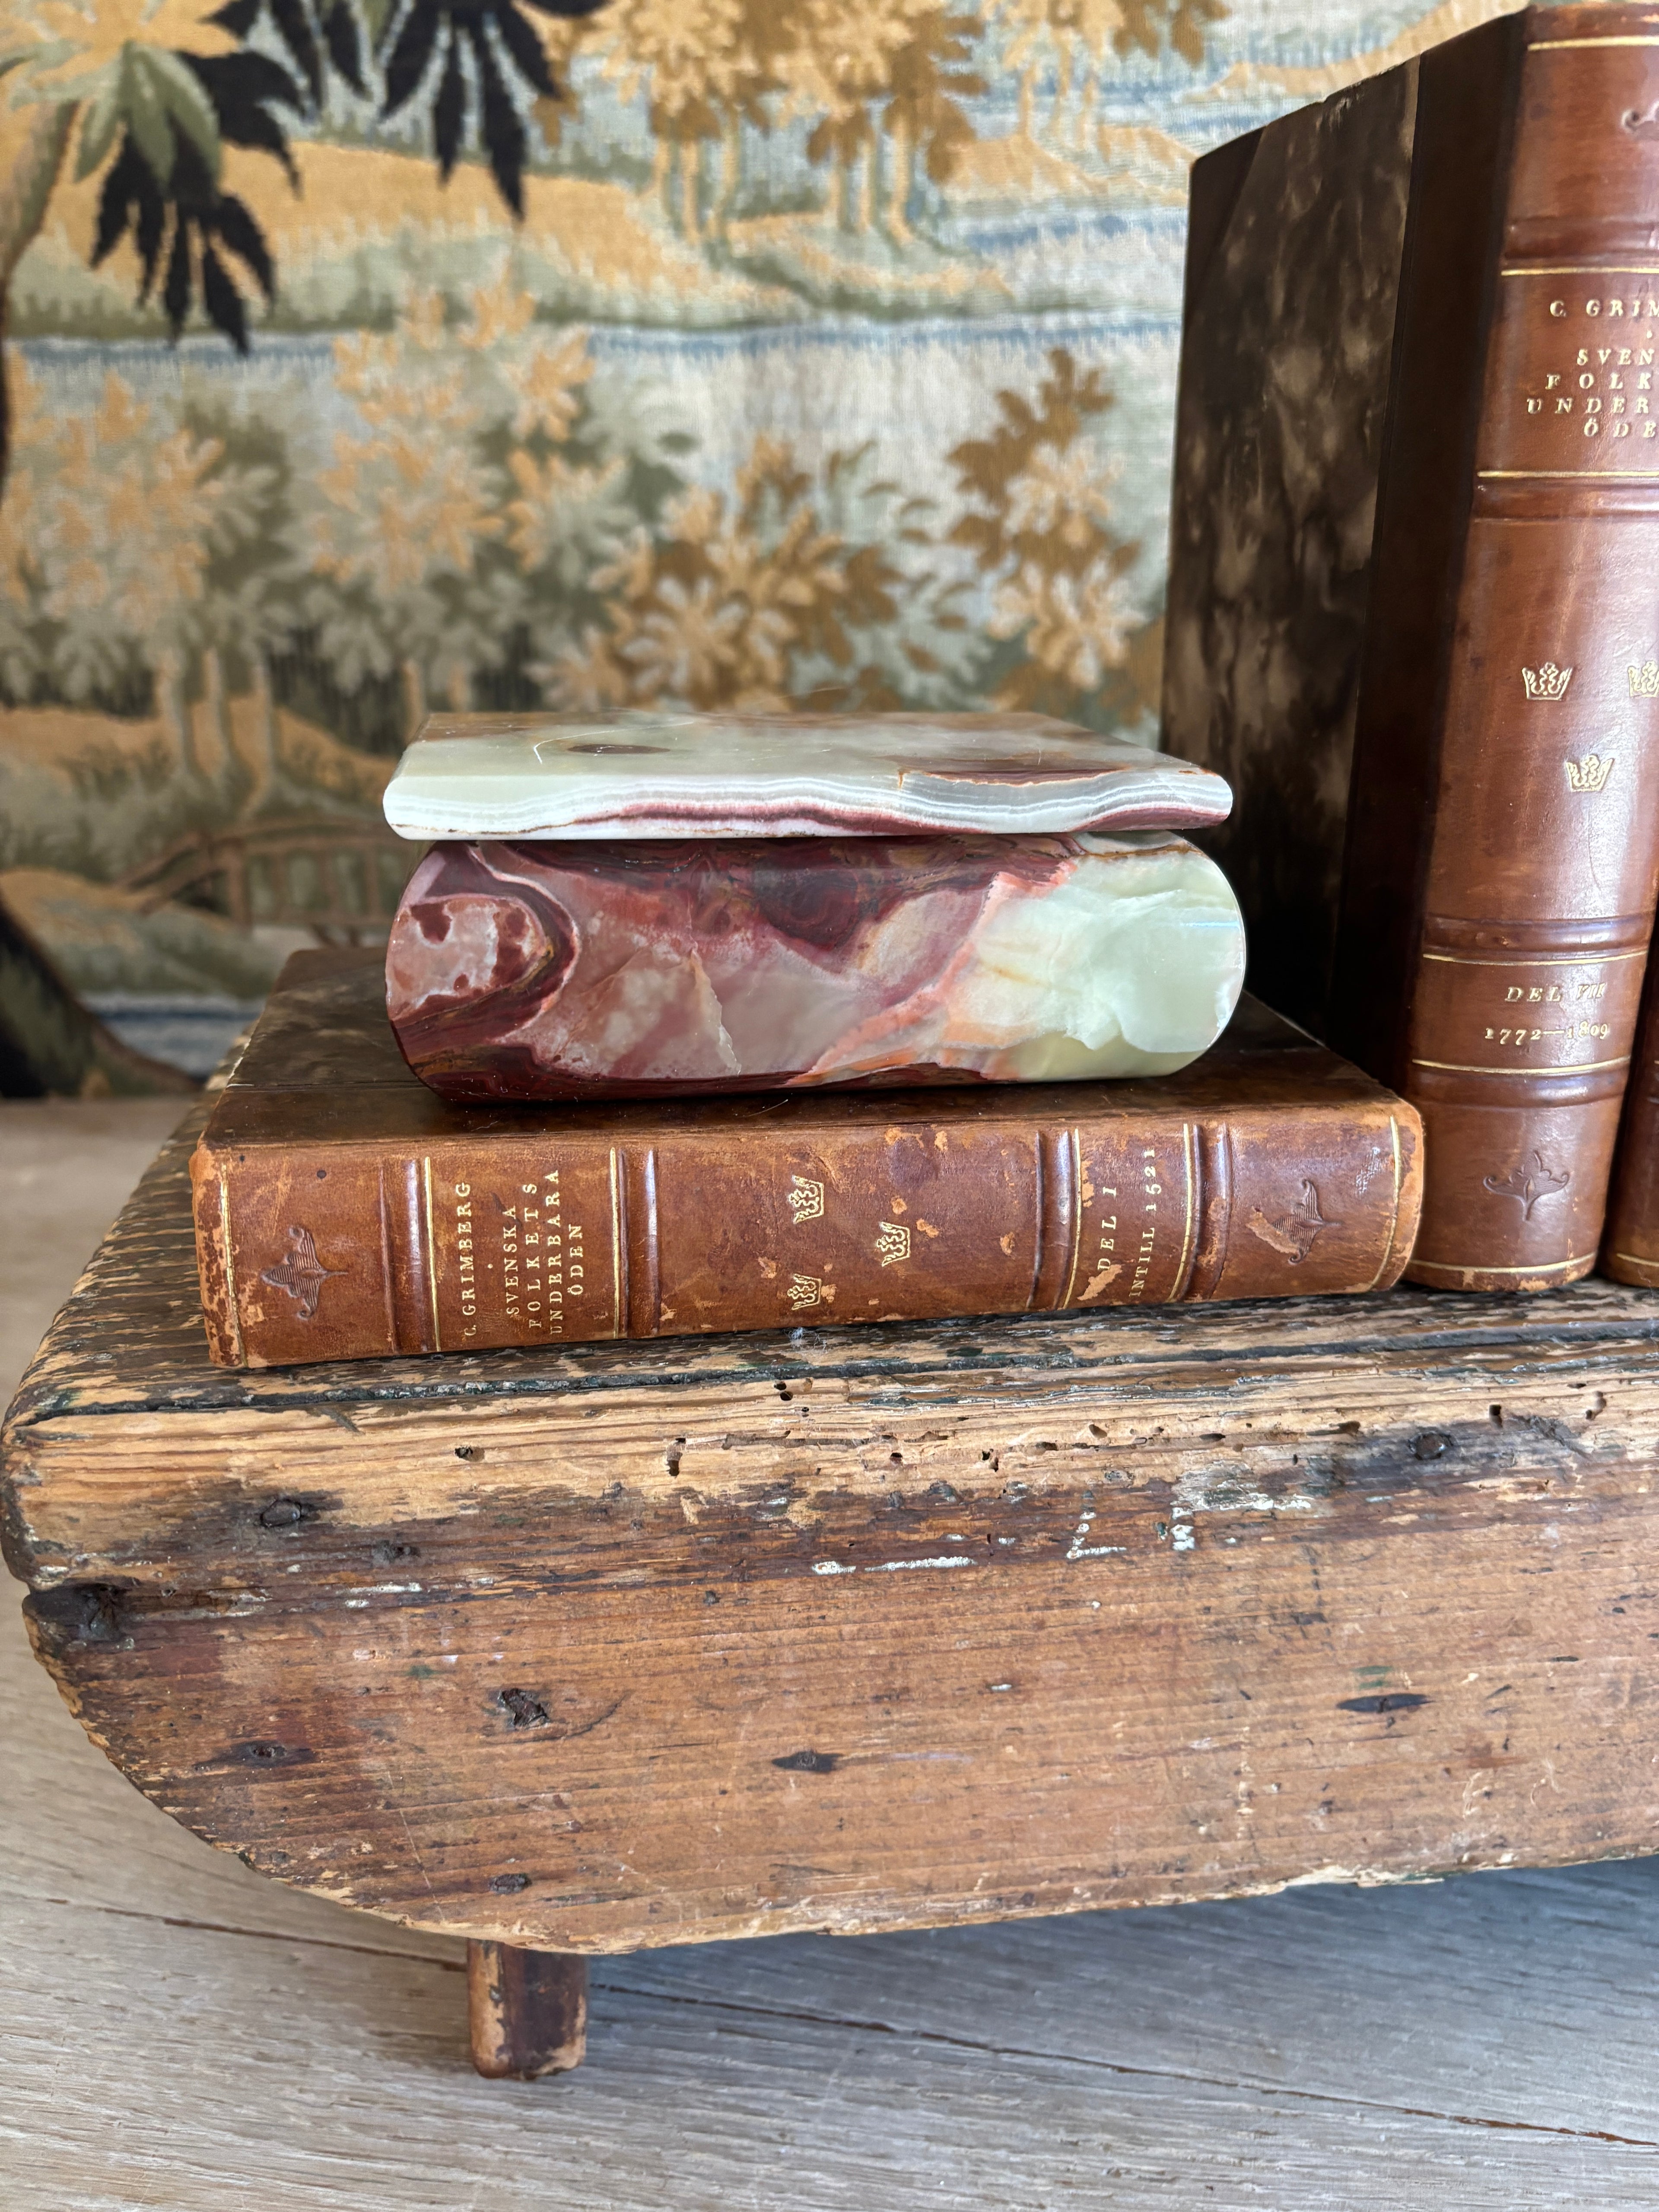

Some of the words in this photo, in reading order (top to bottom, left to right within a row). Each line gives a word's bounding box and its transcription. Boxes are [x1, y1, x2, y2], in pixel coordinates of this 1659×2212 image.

[1526, 397, 1650, 415] UNDER
[1545, 372, 1653, 390] FOLK
[1504, 986, 1562, 1003] DEL
[1102, 1185, 1117, 1196] I
[1128, 1227, 1156, 1297] INTILL
[1144, 1148, 1162, 1212] 1521
[455, 1182, 476, 1316] GRIMBERG
[502, 1205, 520, 1315] SVENSKA
[522, 1182, 542, 1328] FOLKETS
[545, 1170, 563, 1334] UNDERBARA
[567, 1224, 584, 1296] ÖDEN
[1096, 1215, 1117, 1271] DEL
[464, 1324, 477, 1336] C.
